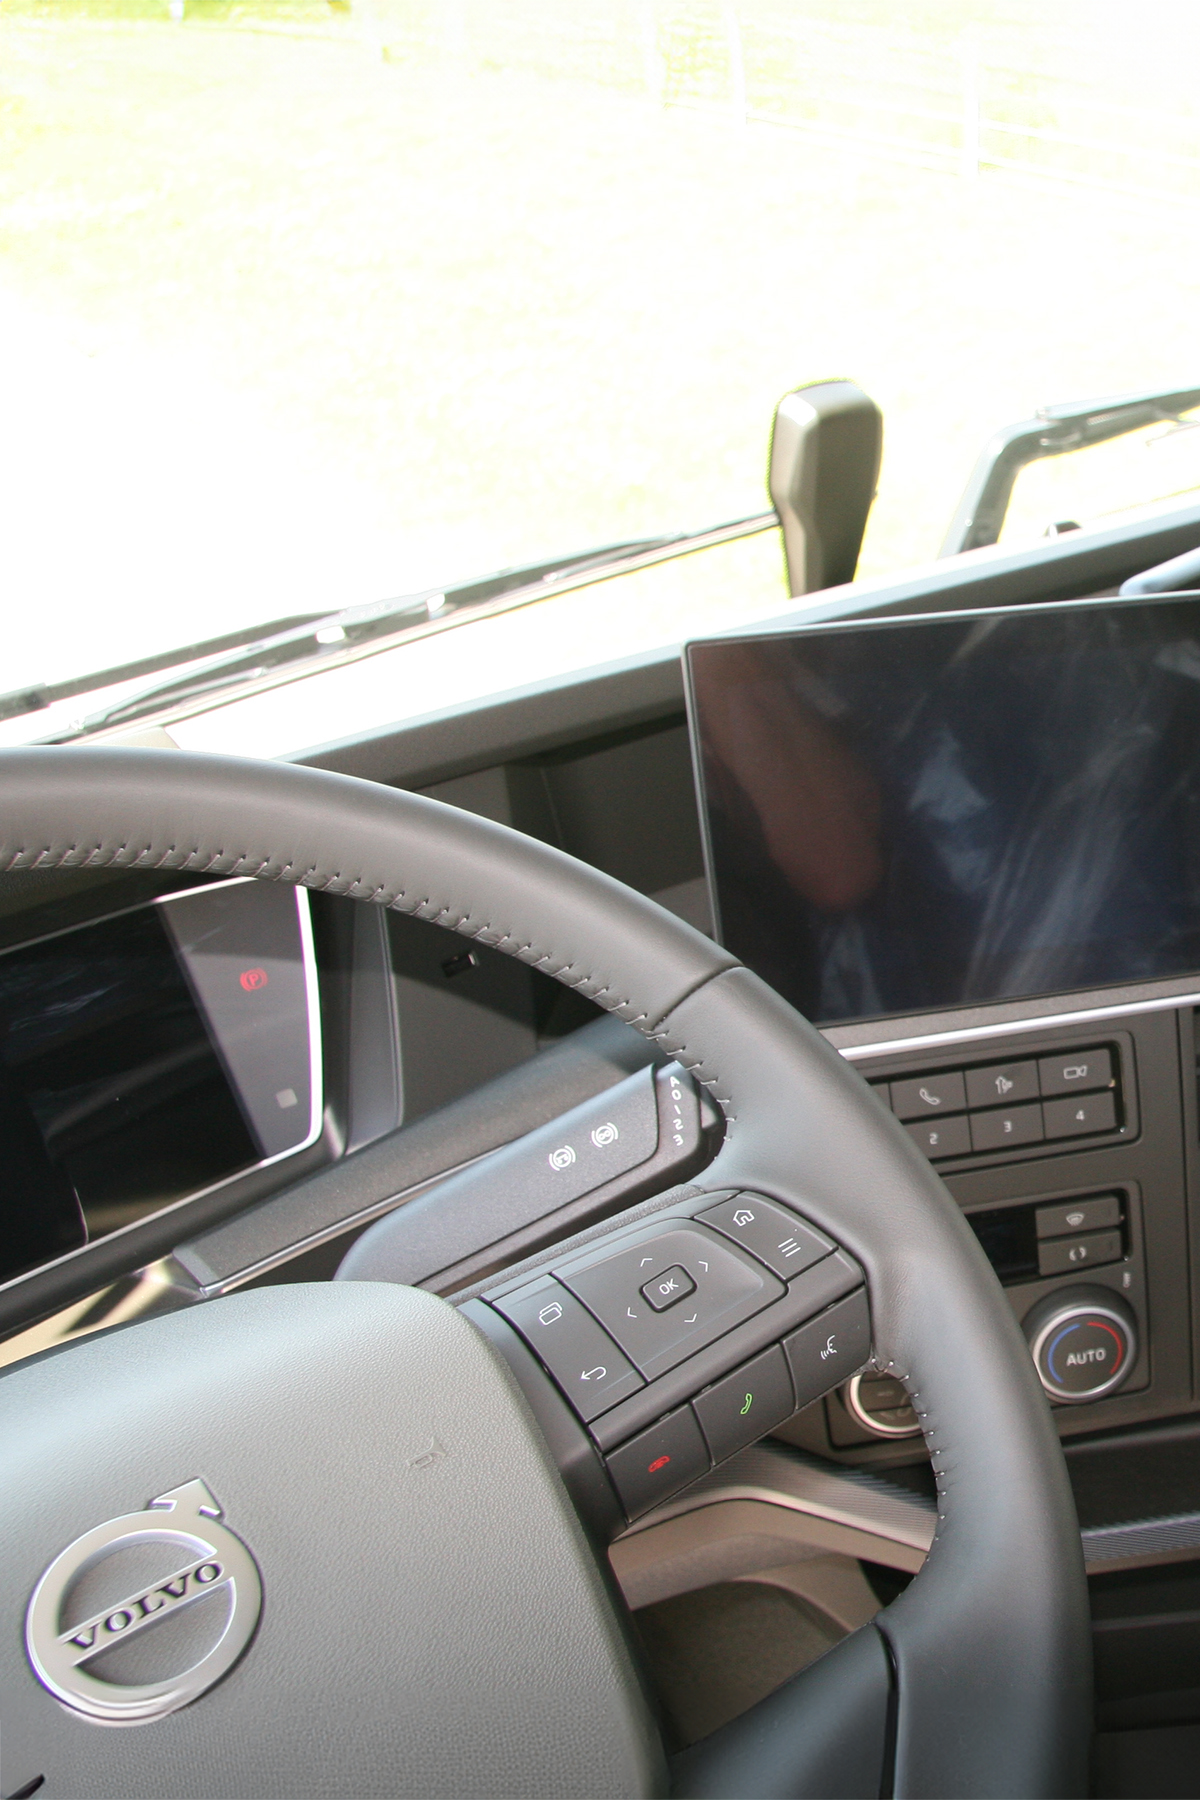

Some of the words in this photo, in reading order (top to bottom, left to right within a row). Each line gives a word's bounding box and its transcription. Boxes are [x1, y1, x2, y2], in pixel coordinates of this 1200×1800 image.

[669, 1075, 680, 1088] A
[1075, 1109, 1085, 1121] 4
[672, 1118, 684, 1130] 2
[1003, 1120, 1012, 1133] 3
[672, 1134, 684, 1146] 3
[929, 1132, 939, 1145] 2
[659, 1278, 679, 1295] OK
[1066, 1347, 1106, 1367] AUTO
[67, 1560, 224, 1650] VOLVO
